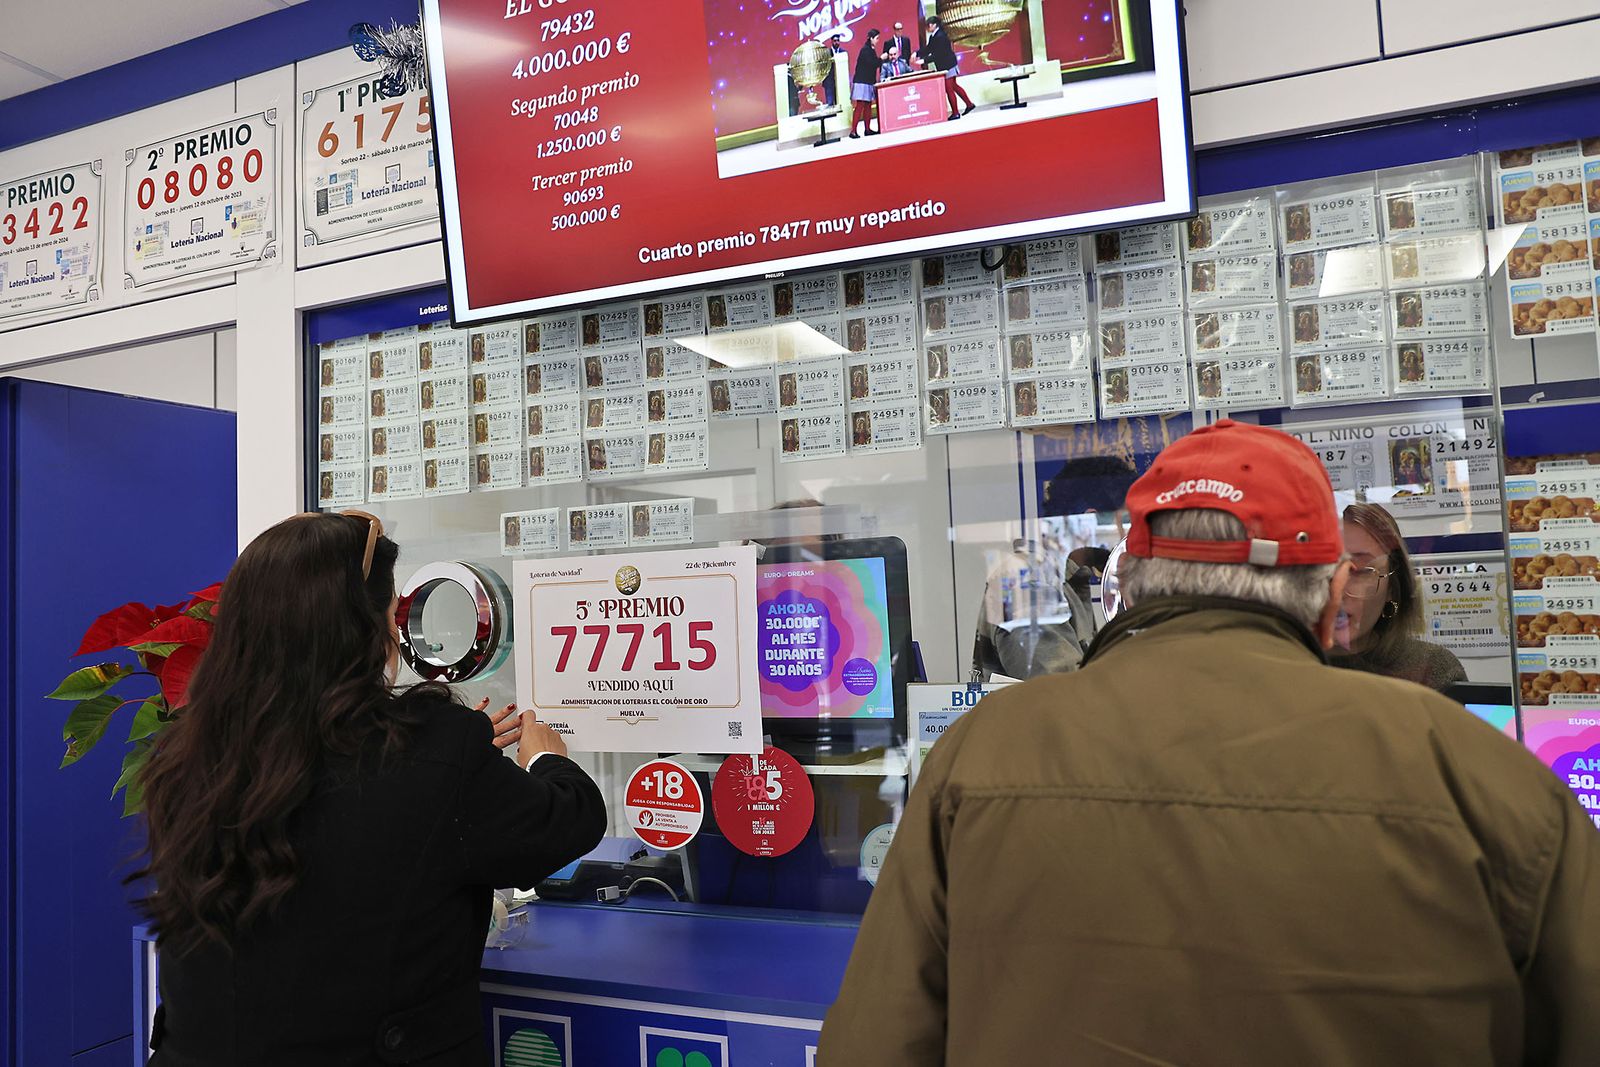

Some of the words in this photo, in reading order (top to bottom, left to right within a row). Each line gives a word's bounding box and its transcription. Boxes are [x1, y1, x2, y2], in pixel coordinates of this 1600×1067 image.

[540, 10, 594, 42] 79432
[512, 38, 610, 80] 4.000.000
[616, 32, 630, 54] €
[511, 85, 577, 118] Segundo
[580, 72, 640, 104] premio
[554, 106, 598, 130] 70048
[148, 148, 164, 172] 2º
[175, 124, 252, 164] PREMIO
[536, 130, 606, 158] 1.250.000
[610, 126, 622, 142] €
[341, 156, 358, 166] Sorteo
[407, 140, 424, 150] marzo
[138, 149, 262, 209] 08080
[532, 170, 576, 191] Tercer
[580, 158, 632, 186] premio
[8, 173, 75, 208] PREMIO
[362, 184, 390, 200] Lotería
[392, 176, 426, 192] Nacional
[563, 186, 604, 206] 90693
[3, 196, 88, 245] 3422
[551, 207, 607, 230] 500.000
[610, 204, 620, 219] €
[638, 242, 692, 263] Cuarto
[696, 231, 756, 262] premio
[760, 220, 810, 244] 78477
[816, 214, 854, 235] muy
[860, 199, 946, 228] repartido
[171, 237, 194, 248] Lotería
[196, 229, 224, 242] Nacional
[1028, 240, 1063, 250] 24951
[30, 272, 55, 284] Nacional
[765, 272, 784, 280] PHILIPS
[866, 269, 898, 280] 24951
[1126, 269, 1164, 280] 93059
[794, 280, 825, 290] 21062
[1546, 281, 1592, 294] 58133
[728, 292, 758, 303] 34603
[948, 292, 982, 304] 91314
[1425, 288, 1466, 298] 39443
[420, 304, 448, 316] Loterías
[664, 302, 692, 312] 33944
[600, 312, 628, 322] 07425
[868, 315, 900, 326] 24951
[1128, 318, 1166, 330] 23190
[486, 330, 510, 340] 80427
[950, 342, 984, 352] 07425
[1427, 342, 1468, 354] 33944
[602, 354, 630, 363] 07425
[1324, 352, 1366, 364] 91889
[870, 362, 902, 372] 24951
[1131, 364, 1168, 376] 90160
[488, 371, 510, 380] 80427
[799, 371, 828, 381] 21062
[730, 379, 760, 388] 34603
[667, 388, 694, 398] 33944
[953, 388, 986, 398] 16096
[606, 396, 634, 406] 07425
[488, 412, 512, 422] 80427
[873, 409, 904, 419] 24951
[800, 416, 830, 426] 21062
[606, 438, 634, 448] 07425
[668, 432, 696, 442] 33944
[1437, 438, 1496, 453] 21492
[490, 452, 513, 462] 80427
[1156, 478, 1244, 504] cruzcampo
[1540, 482, 1586, 493] 24951
[588, 510, 615, 520] 33944
[652, 504, 680, 514] 78144
[522, 515, 547, 524] 41515
[1544, 540, 1590, 550] 24951
[1432, 581, 1491, 594] 92644
[598, 596, 684, 620] PREMIO
[768, 603, 816, 615] AHORA
[1546, 599, 1593, 609] 24951
[772, 634, 788, 645] AL
[790, 633, 816, 644] MES
[550, 621, 716, 672] 77715
[766, 648, 824, 661] DURANTE
[1550, 657, 1596, 668] 24951
[770, 664, 786, 676] 30
[788, 662, 822, 676] AÑOS
[587, 680, 640, 692] VENDIDO
[642, 677, 674, 694] AQUÍ
[660, 696, 684, 705] COLÓN
[640, 770, 684, 800] +18
[766, 770, 782, 800] 5
